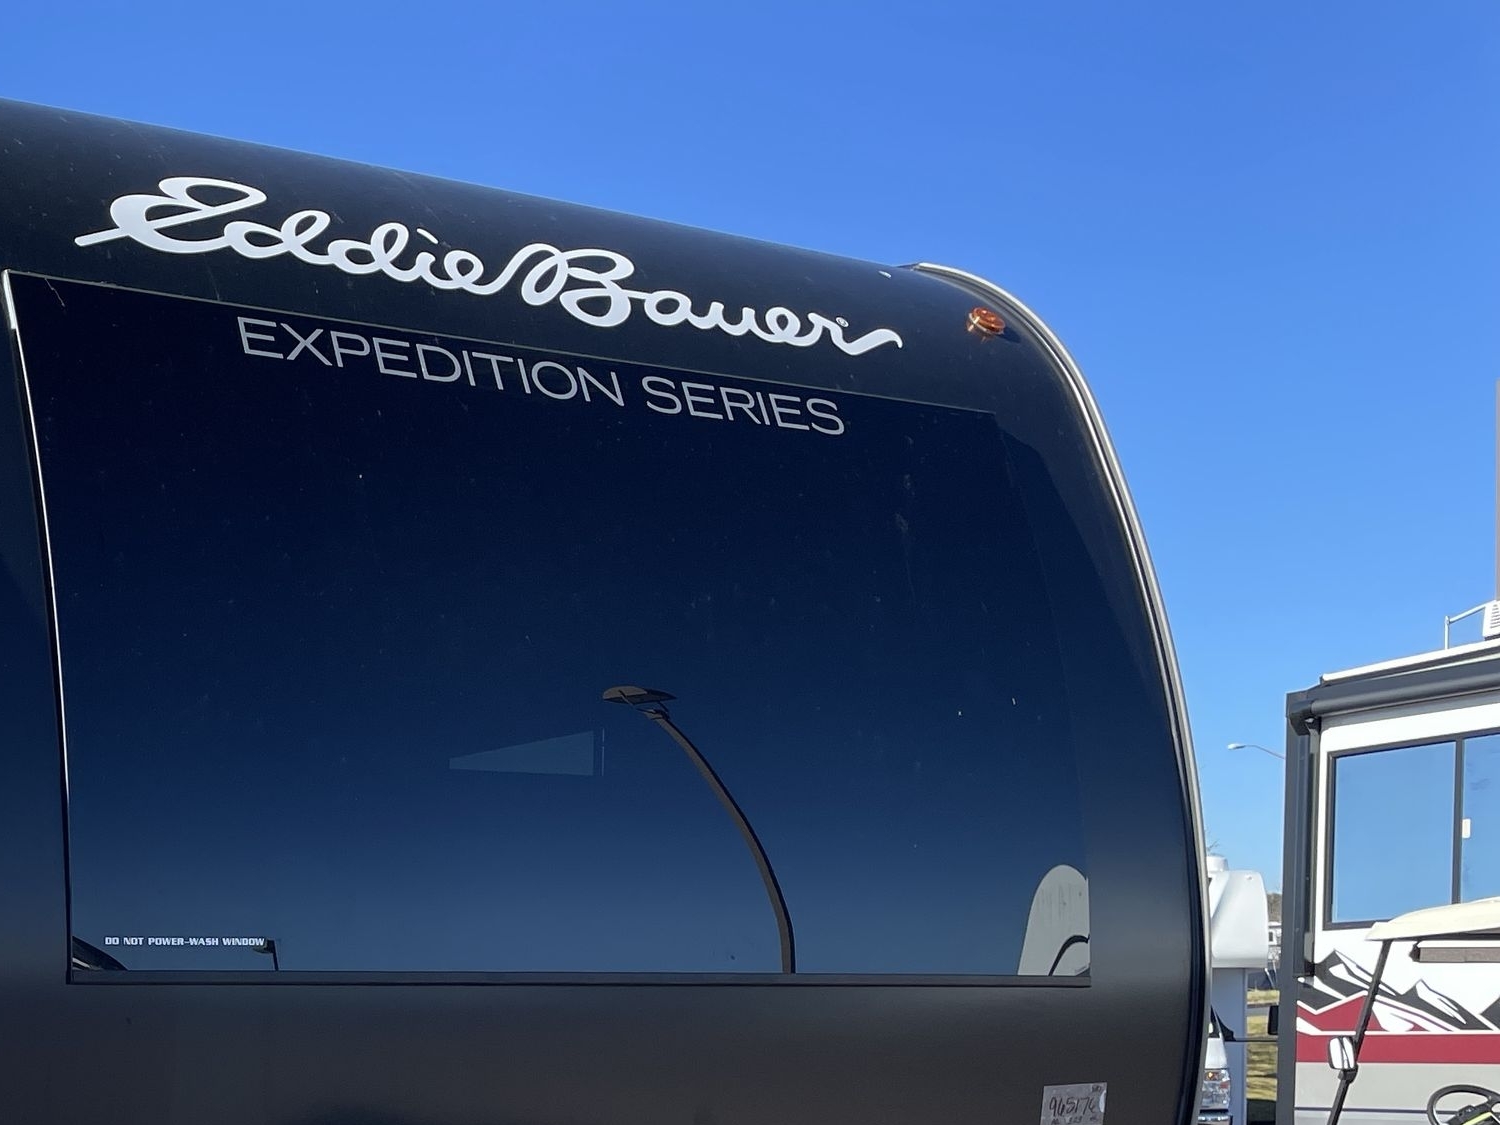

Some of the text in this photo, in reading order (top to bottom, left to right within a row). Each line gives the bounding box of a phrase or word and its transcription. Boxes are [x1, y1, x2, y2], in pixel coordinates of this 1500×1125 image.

[75, 176, 903, 357] Eddie Bauer
[237, 316, 845, 436] EXPEDITION SERIES
[104, 936, 265, 947] DO NOT POWER-WASH WINDOW
